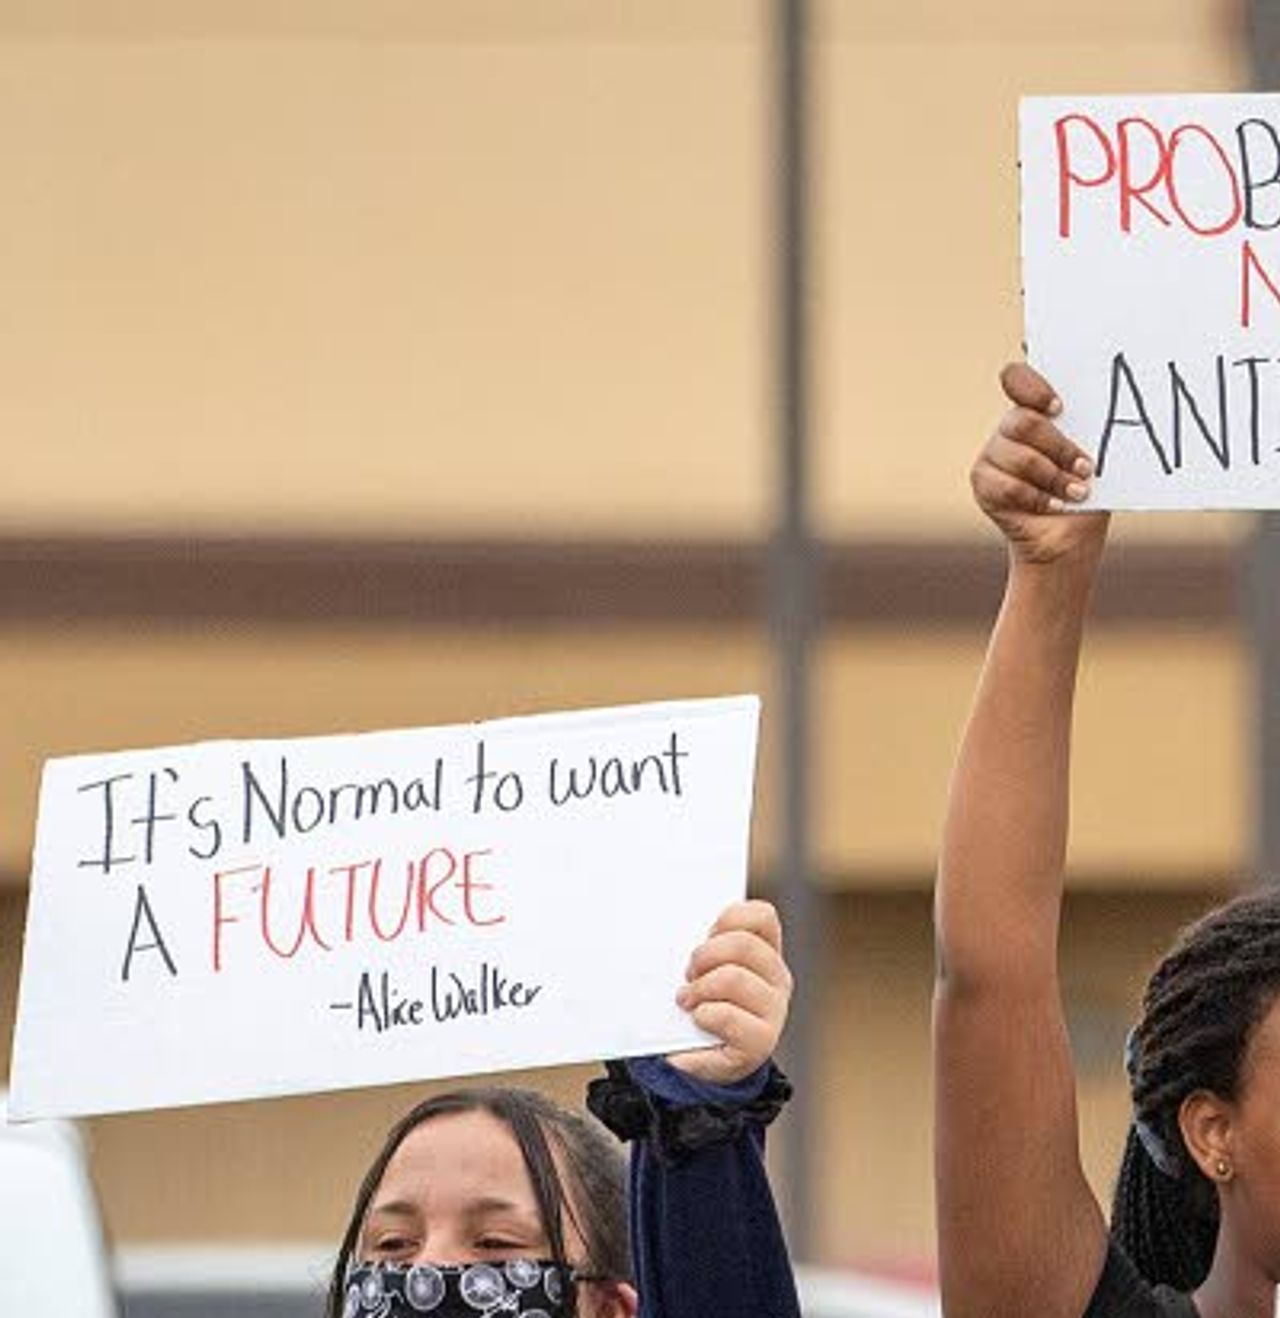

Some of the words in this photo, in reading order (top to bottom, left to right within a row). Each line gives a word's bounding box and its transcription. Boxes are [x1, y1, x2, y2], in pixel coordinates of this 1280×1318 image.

[79, 767, 222, 874] It's
[242, 757, 443, 843] Normal
[467, 741, 524, 814] to
[549, 732, 690, 805] want
[121, 885, 177, 981] A
[211, 847, 507, 972] FUTURE
[431, 964, 542, 1022] Walker
